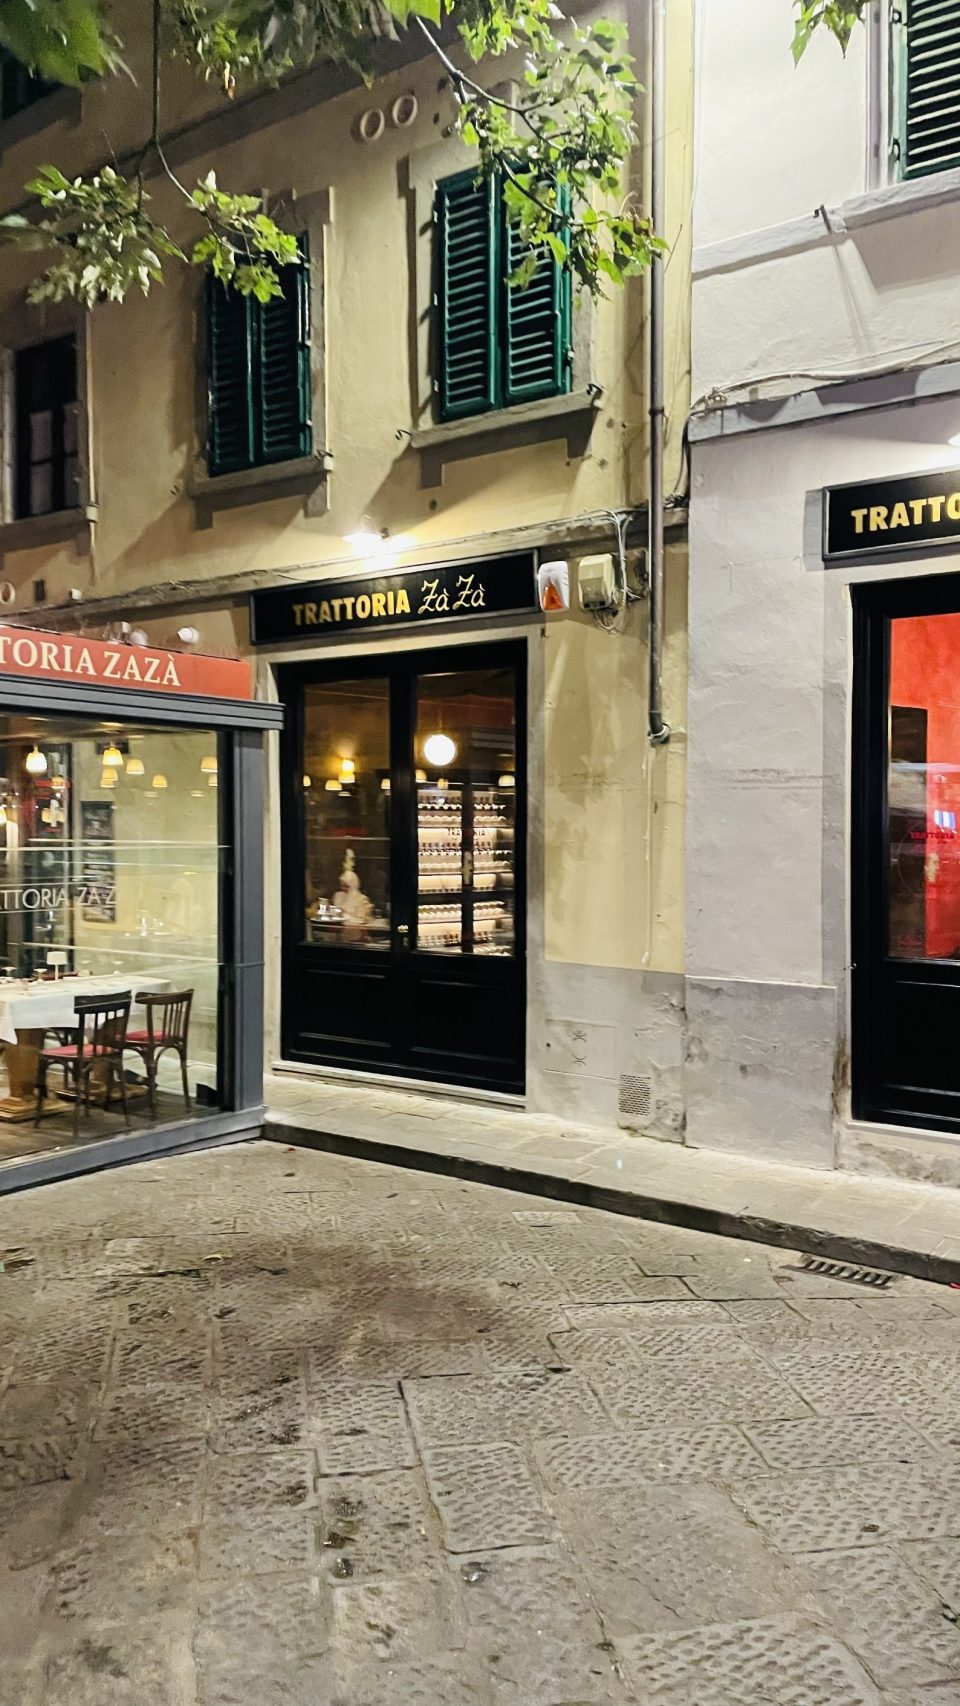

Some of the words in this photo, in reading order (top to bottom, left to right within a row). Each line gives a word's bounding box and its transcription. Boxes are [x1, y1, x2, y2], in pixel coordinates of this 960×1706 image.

[292, 589, 411, 626] TRATTORIA
[417, 578, 450, 615] Zà
[452, 574, 486, 610] Zà
[103, 651, 181, 687] ZAZÀ
[0, 888, 69, 909] TTORIA
